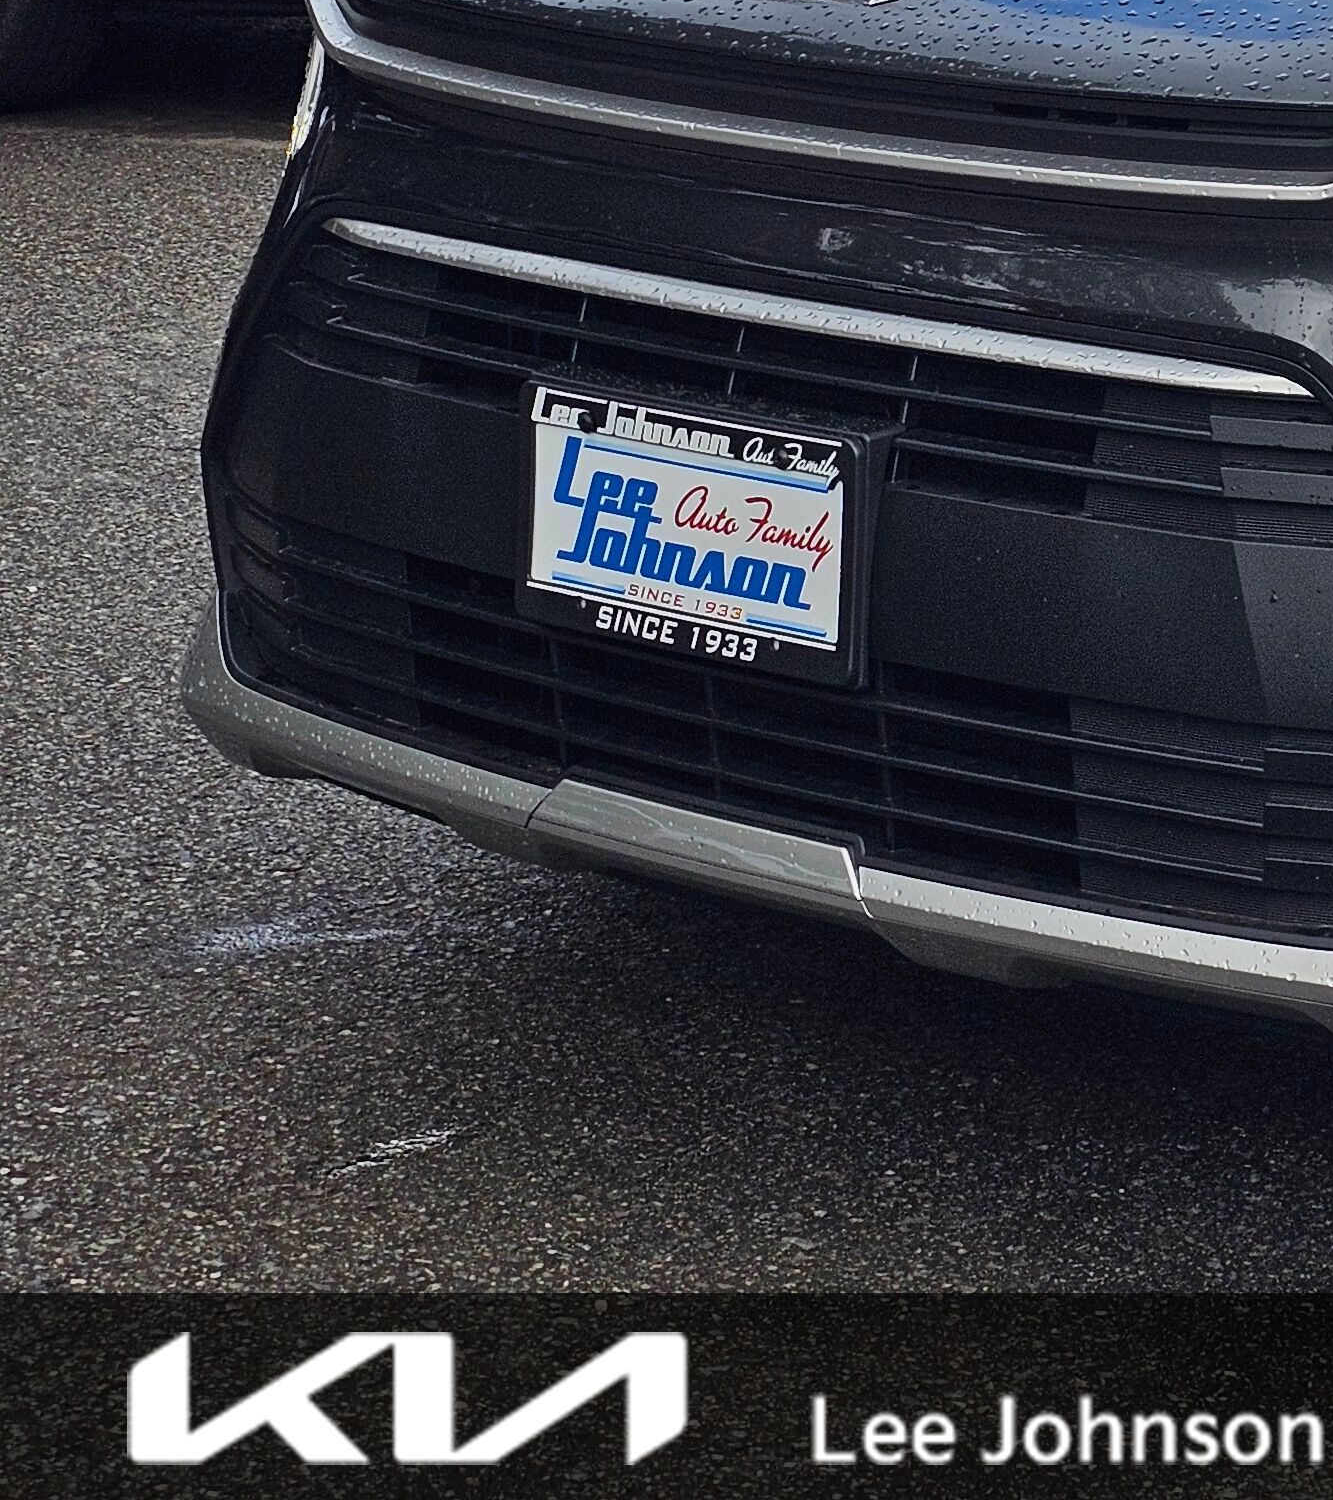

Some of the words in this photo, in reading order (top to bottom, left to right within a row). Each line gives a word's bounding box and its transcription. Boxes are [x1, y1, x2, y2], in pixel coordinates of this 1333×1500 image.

[553, 435, 662, 524] Lee
[596, 400, 736, 459] Johnson
[742, 436, 778, 466] Aut
[784, 442, 841, 488] Family
[556, 504, 812, 611] Johnson
[673, 485, 740, 536] Auto
[745, 496, 834, 572] Family
[594, 606, 680, 645] SINCE
[690, 626, 758, 663] 1933
[627, 582, 686, 609] SINCE
[694, 598, 744, 621] 1933
